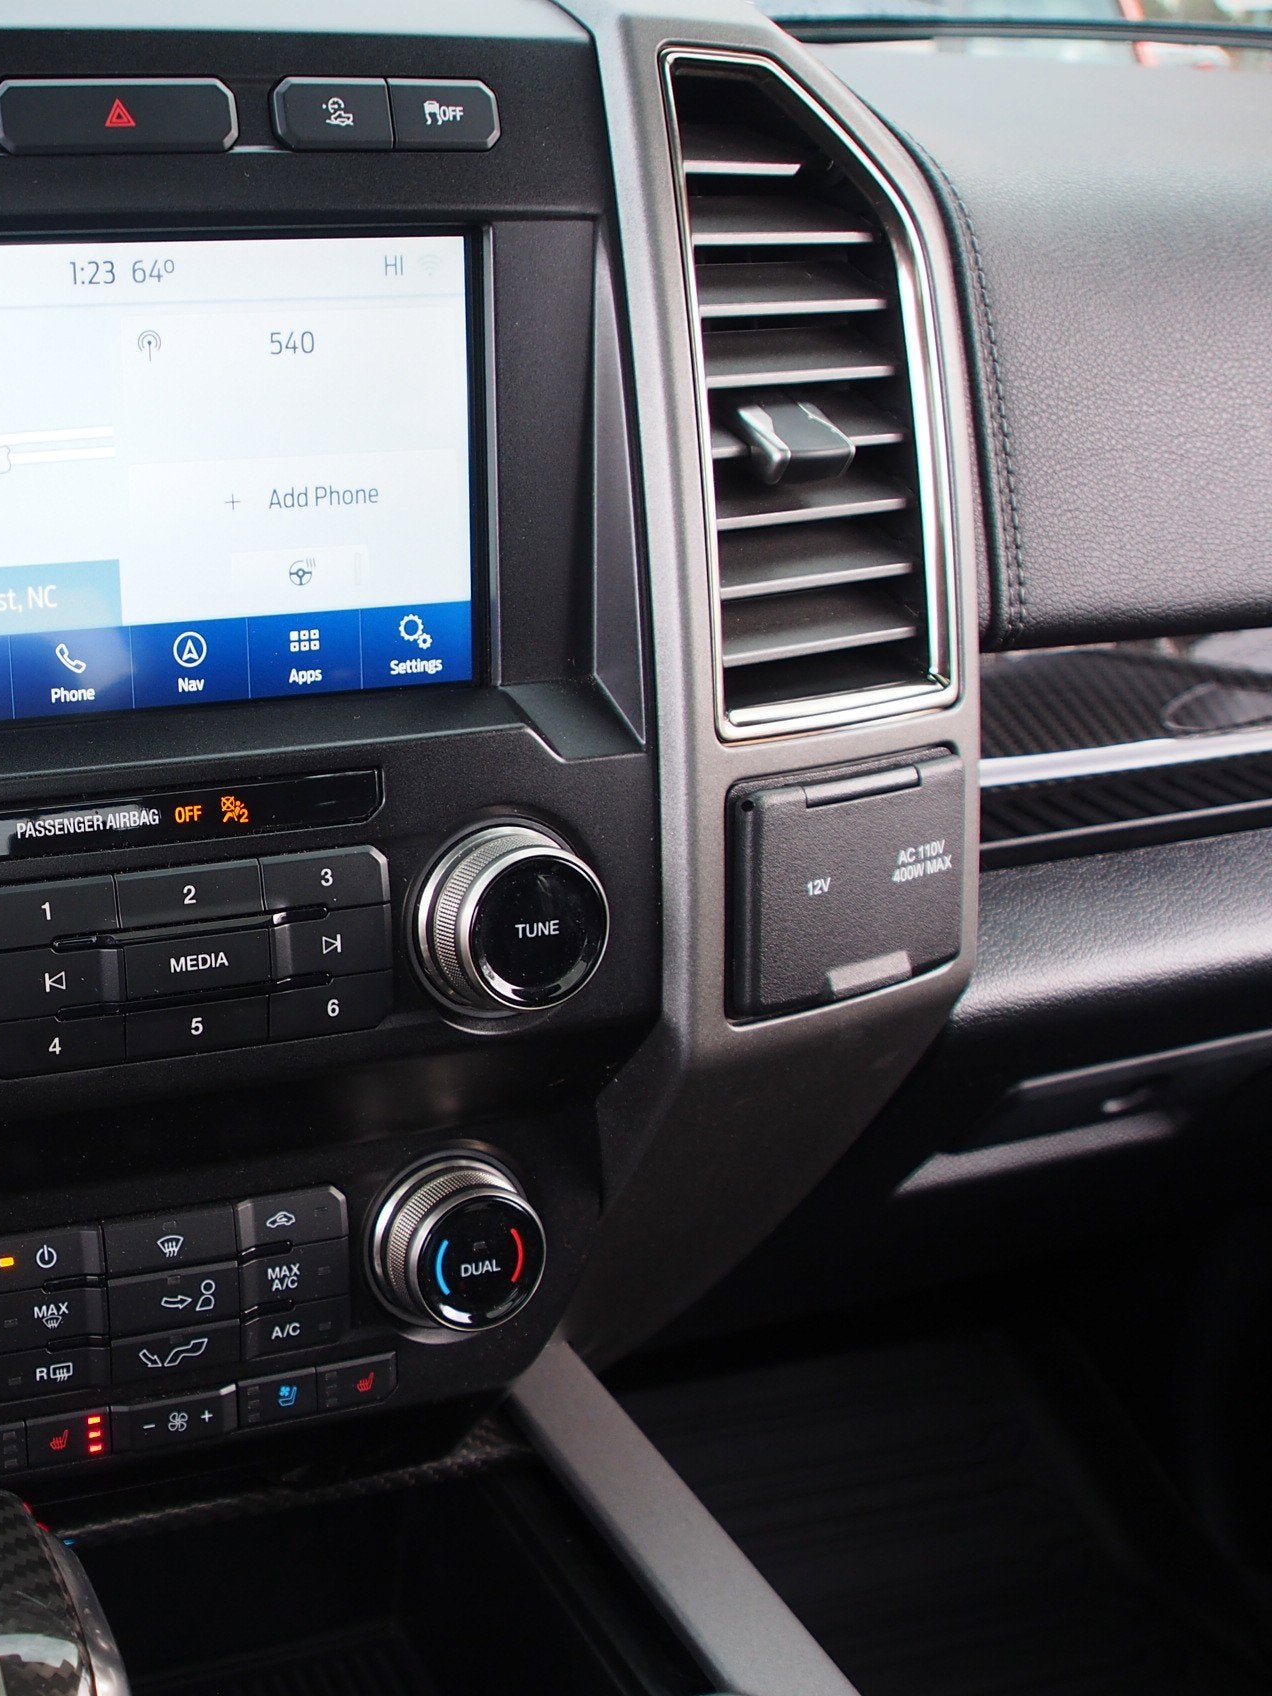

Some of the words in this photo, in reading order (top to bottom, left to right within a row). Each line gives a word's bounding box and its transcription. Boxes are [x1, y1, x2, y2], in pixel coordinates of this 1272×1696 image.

[439, 106, 464, 122] OFF
[69, 260, 116, 285] 1:23
[383, 255, 404, 276] HI
[269, 331, 315, 355] 540
[268, 487, 308, 510] Add
[314, 486, 379, 507] Phone
[27, 584, 59, 609] NC
[288, 667, 323, 685] Apps
[390, 658, 443, 676] Settings
[178, 677, 205, 693] Nav
[50, 687, 96, 704] Phone
[16, 815, 103, 839] PASSENGER
[106, 808, 160, 831] AIRBAG
[174, 805, 203, 824] OFF
[896, 847, 916, 866] AC
[918, 839, 946, 860] 110V
[320, 868, 334, 887] 3
[891, 863, 925, 883] 400W
[927, 855, 953, 875] MAX
[182, 885, 197, 905] 2
[806, 877, 831, 896] 12V
[41, 901, 52, 921] 1
[515, 920, 560, 938] TUNE
[169, 951, 230, 974] MEDIA
[327, 998, 340, 1018] 6
[190, 1017, 204, 1037] 5
[48, 1035, 62, 1055] 4
[267, 1263, 301, 1280] MAX
[460, 1259, 501, 1278] DUAL
[271, 1276, 299, 1291] A/C
[33, 1302, 69, 1319] MAX
[271, 1323, 301, 1339] A/C
[35, 1367, 47, 1381] R
